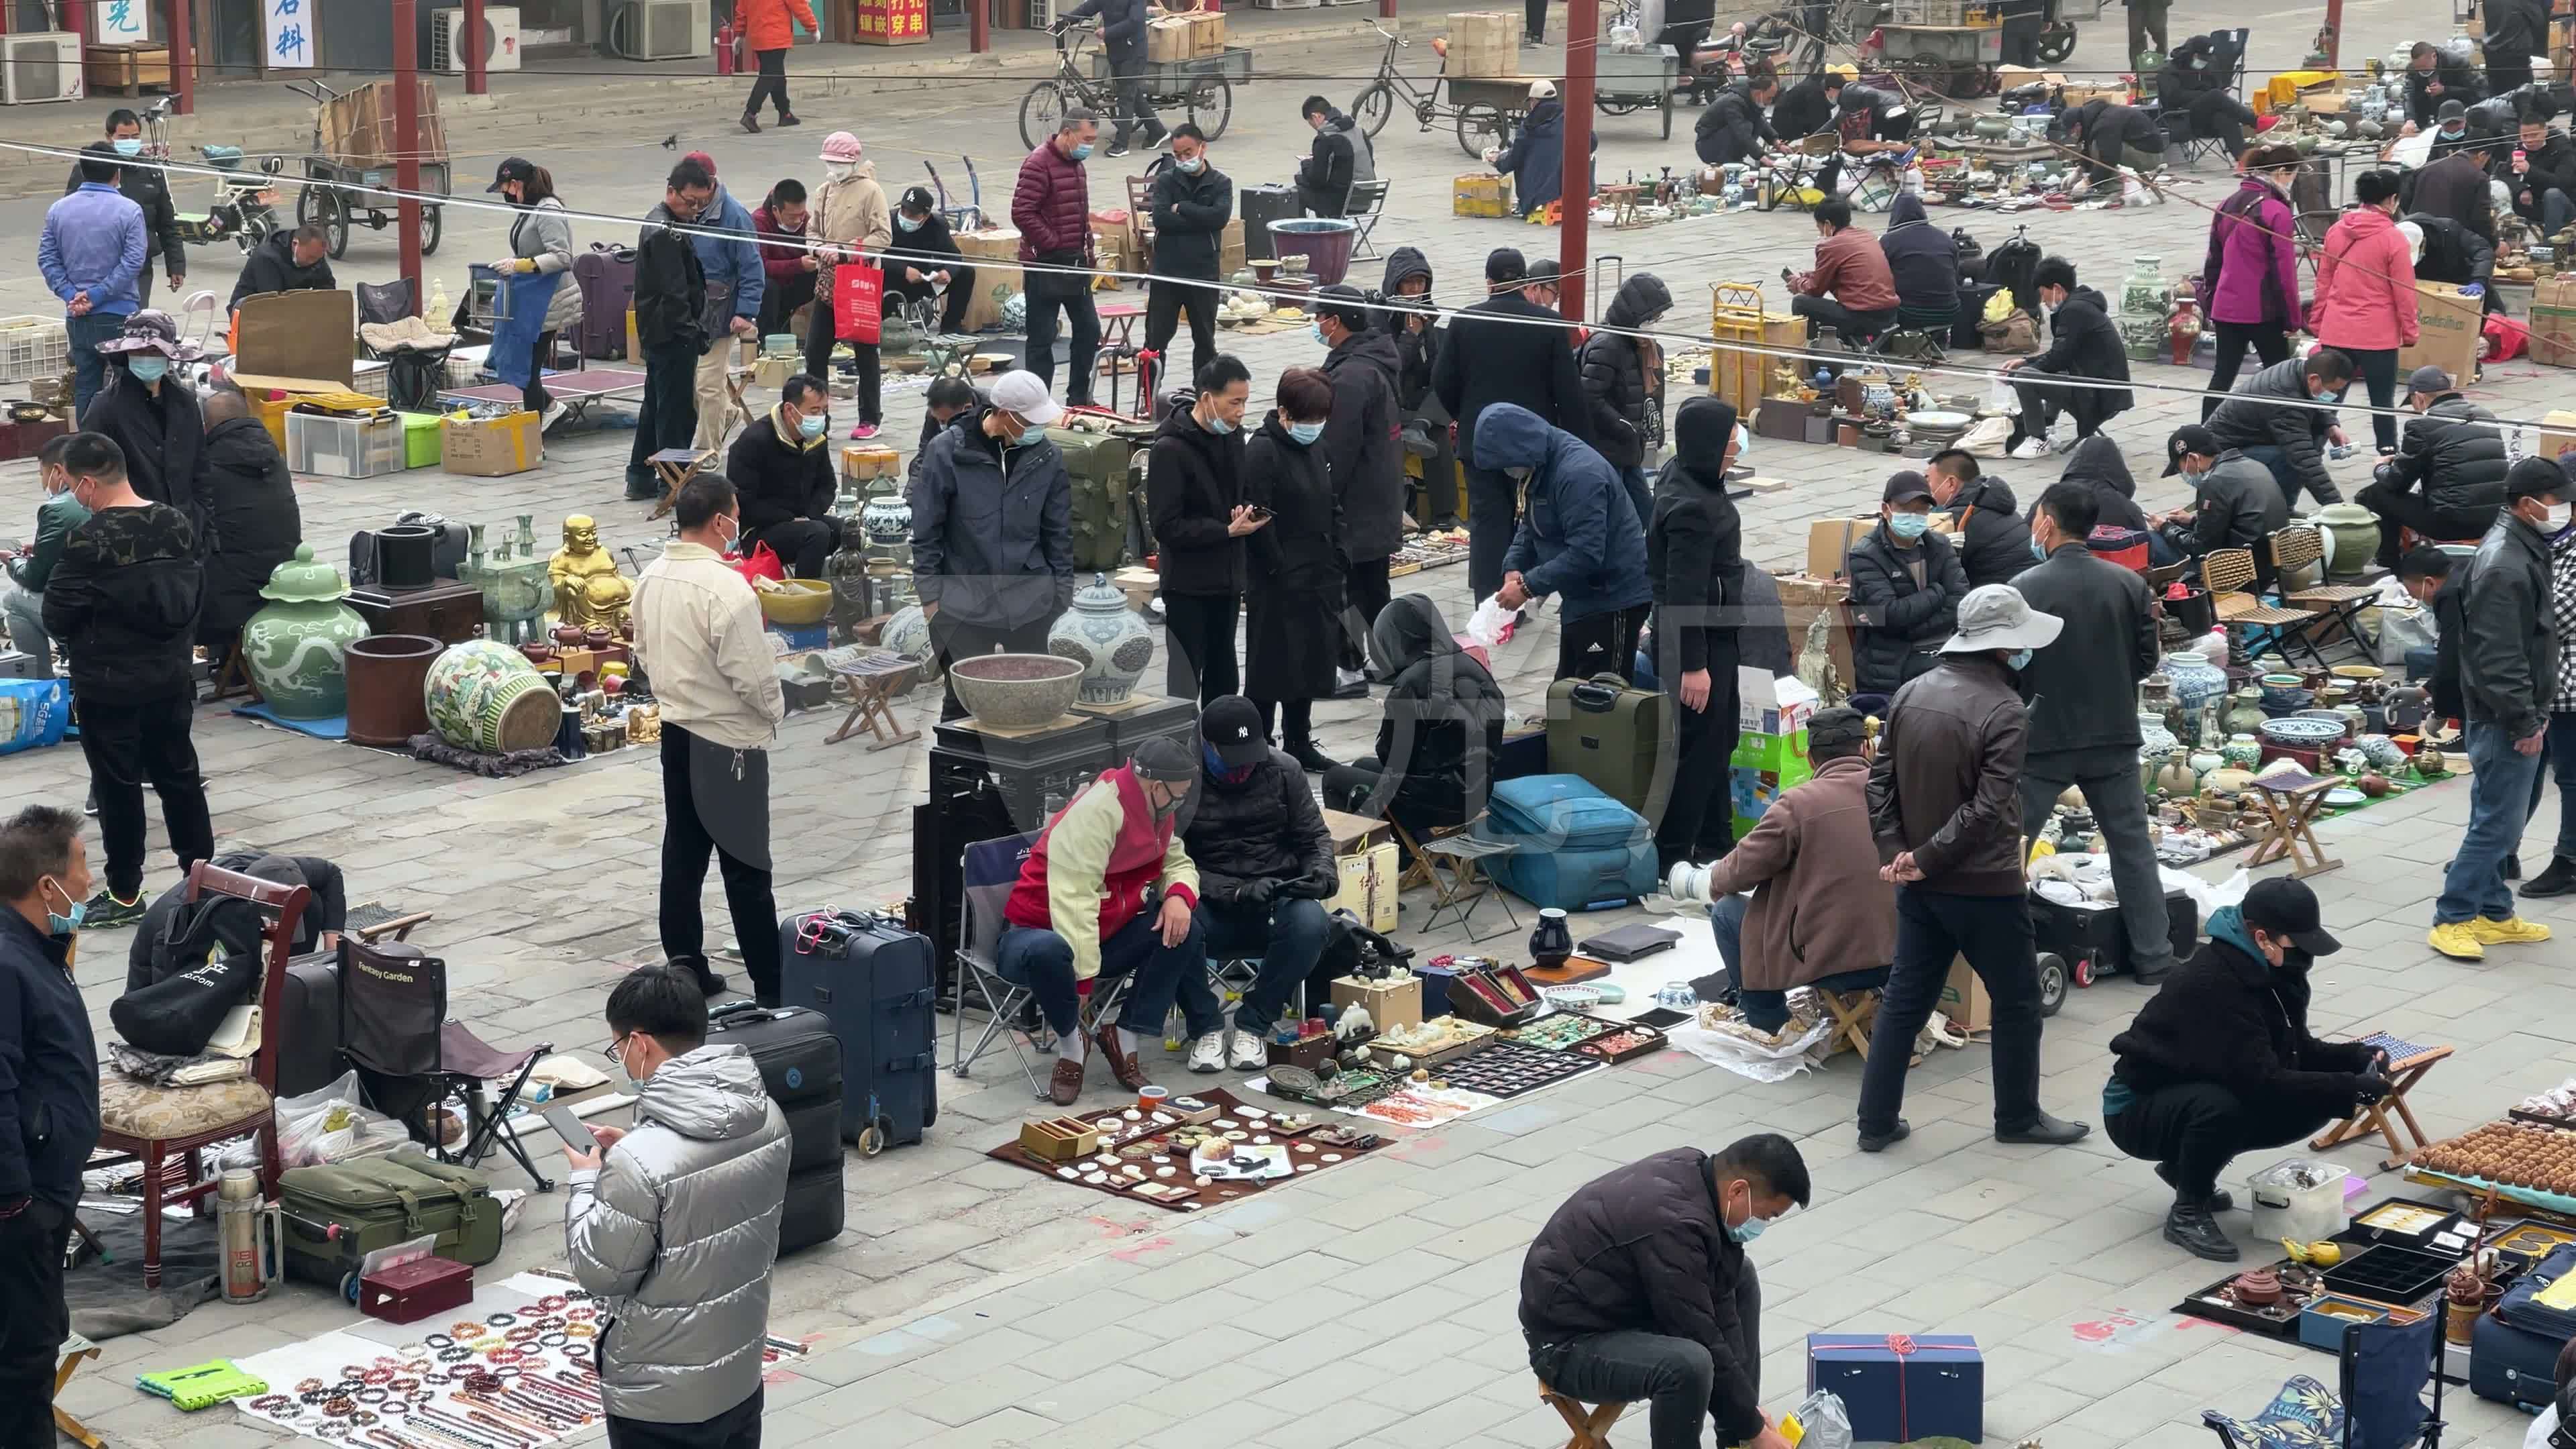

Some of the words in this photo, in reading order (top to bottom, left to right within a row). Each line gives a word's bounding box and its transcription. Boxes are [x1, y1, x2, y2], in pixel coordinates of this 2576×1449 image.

[892, 12, 922, 34] 穿串
[358, 961, 382, 979] Fantasy
[383, 971, 413, 983] Garden
